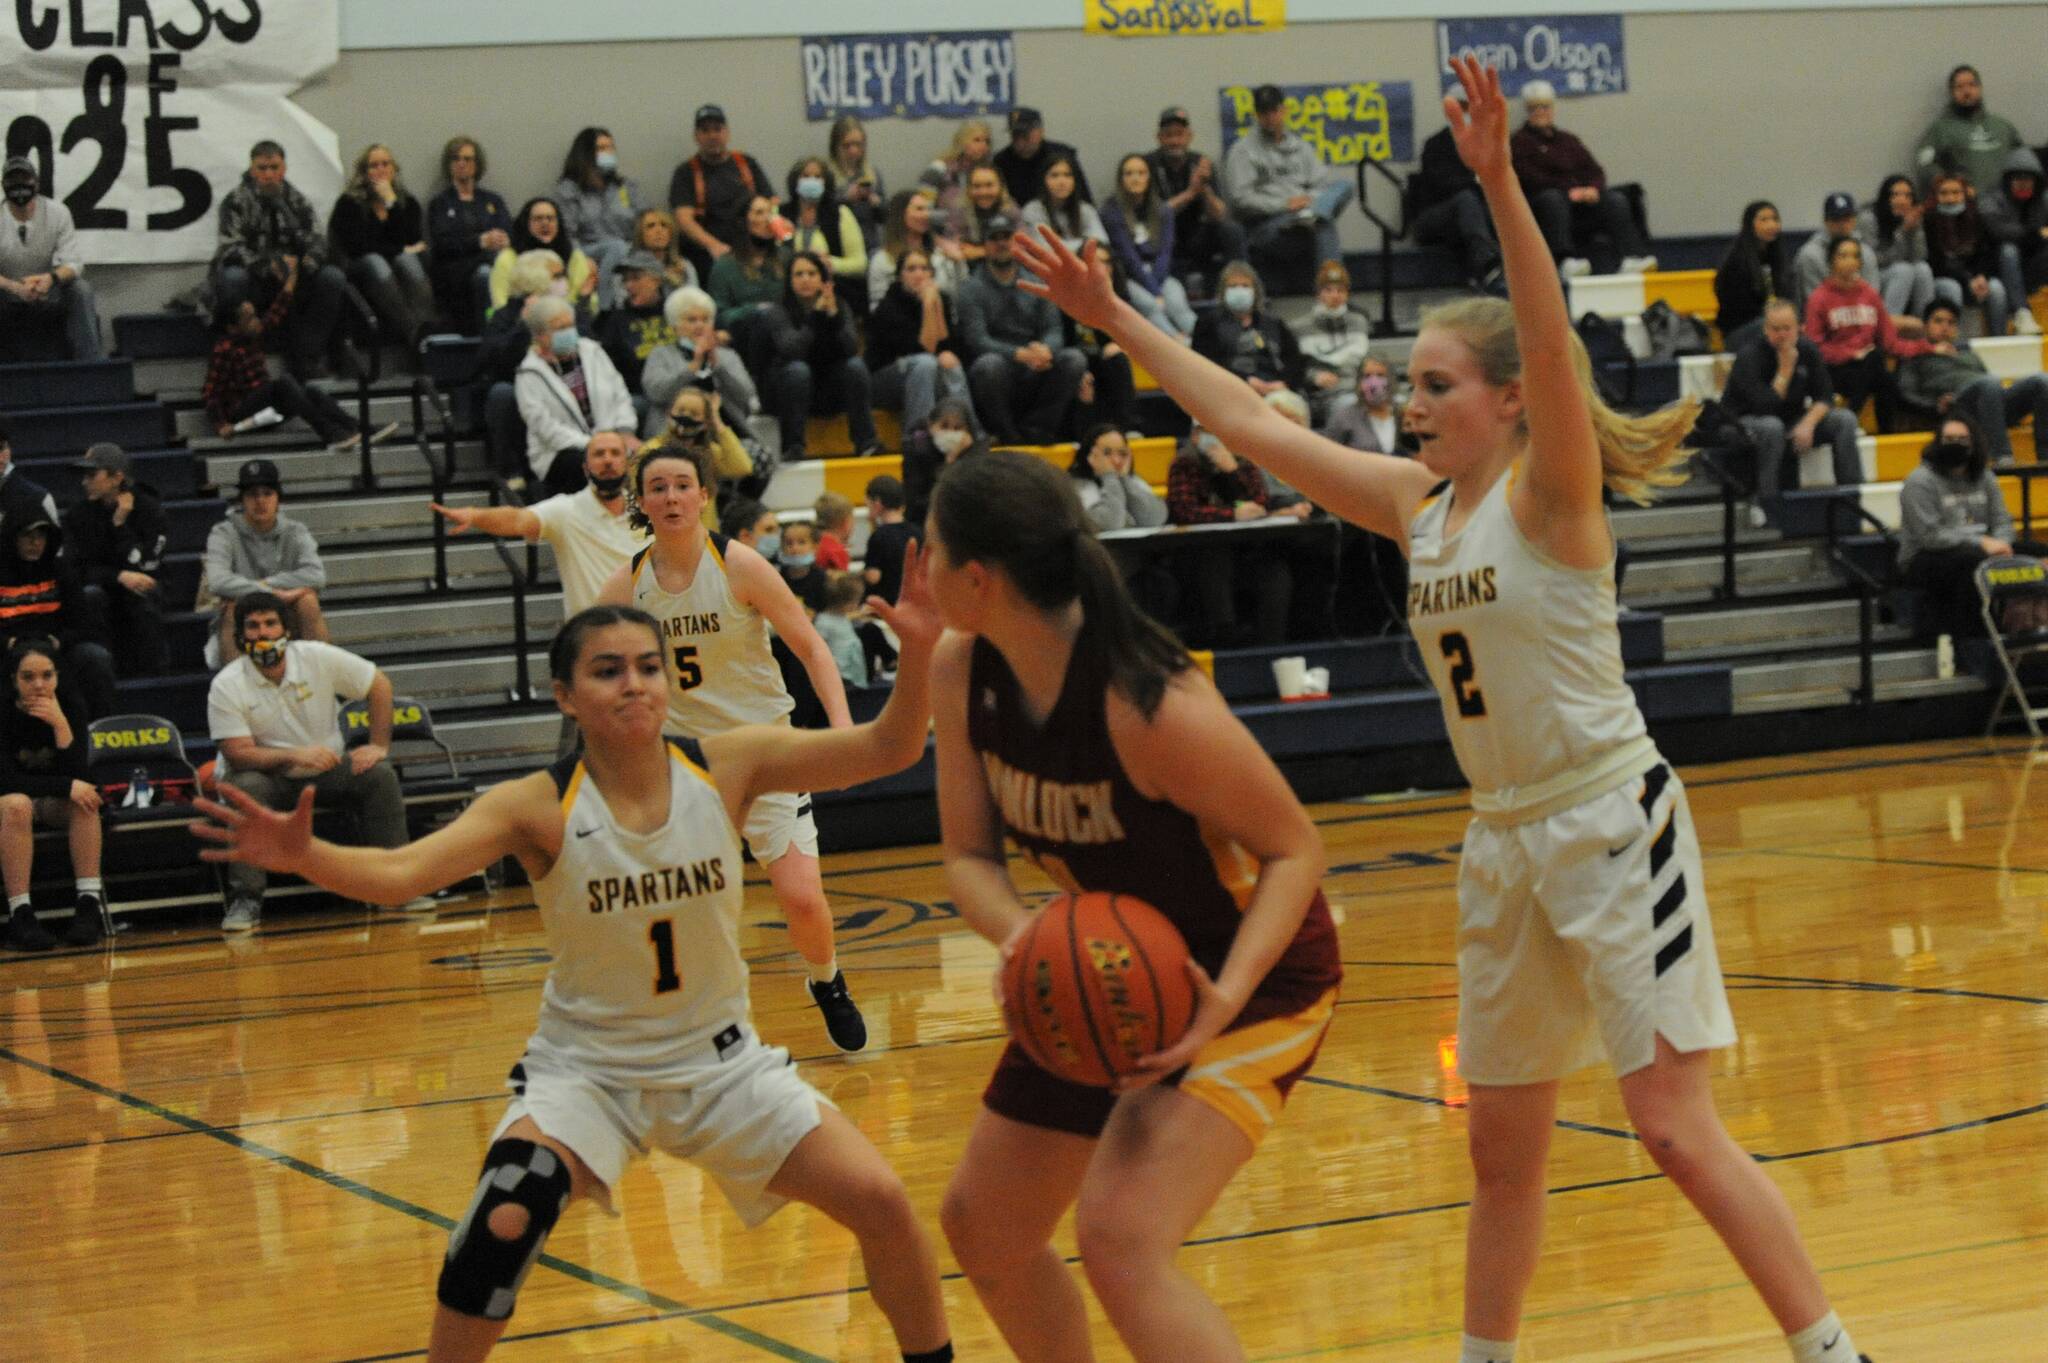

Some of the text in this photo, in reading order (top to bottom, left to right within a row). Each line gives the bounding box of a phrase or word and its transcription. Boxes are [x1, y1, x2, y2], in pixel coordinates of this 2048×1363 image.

[803, 38, 1014, 108] RILEY PURSEY
[1523, 24, 1613, 72] Olson
[83, 54, 181, 118] OF
[1407, 566, 1497, 617] PARTANS
[658, 612, 720, 638] ARTANS
[672, 644, 704, 692] 5
[1439, 629, 1489, 719] 2
[92, 727, 170, 749] FORKS
[347, 706, 422, 729] FOKS
[587, 857, 726, 914] SPARTANS
[649, 918, 683, 996] 1
